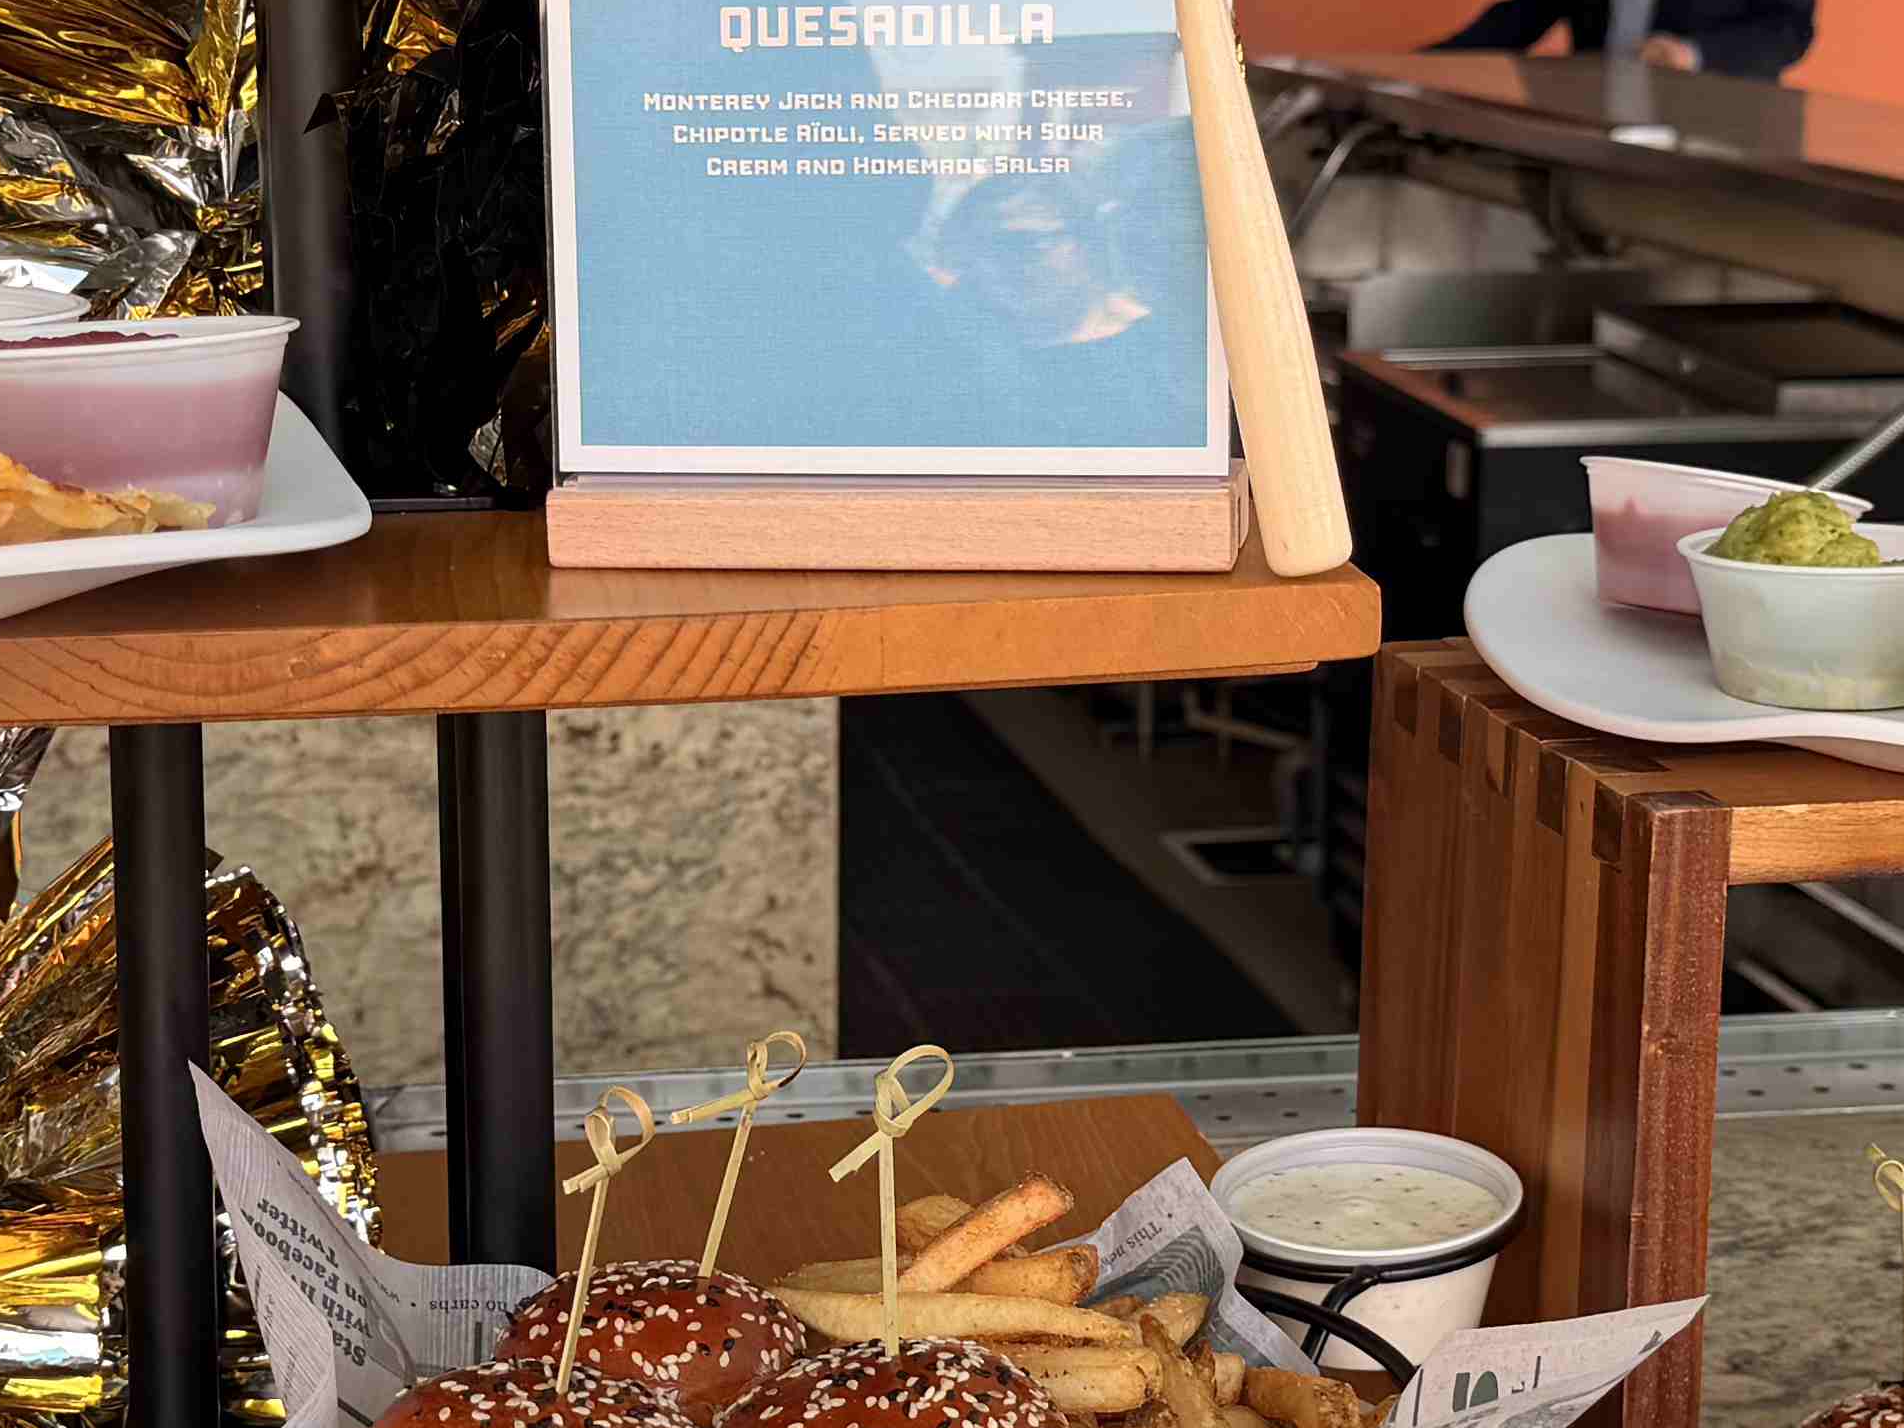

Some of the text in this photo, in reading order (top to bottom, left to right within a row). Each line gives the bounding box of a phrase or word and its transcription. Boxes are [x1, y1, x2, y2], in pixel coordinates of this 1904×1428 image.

[720, 3, 1054, 52] QUESADILLA
[258, 1195, 341, 1267] Twitter
[332, 1325, 369, 1370] Sta
